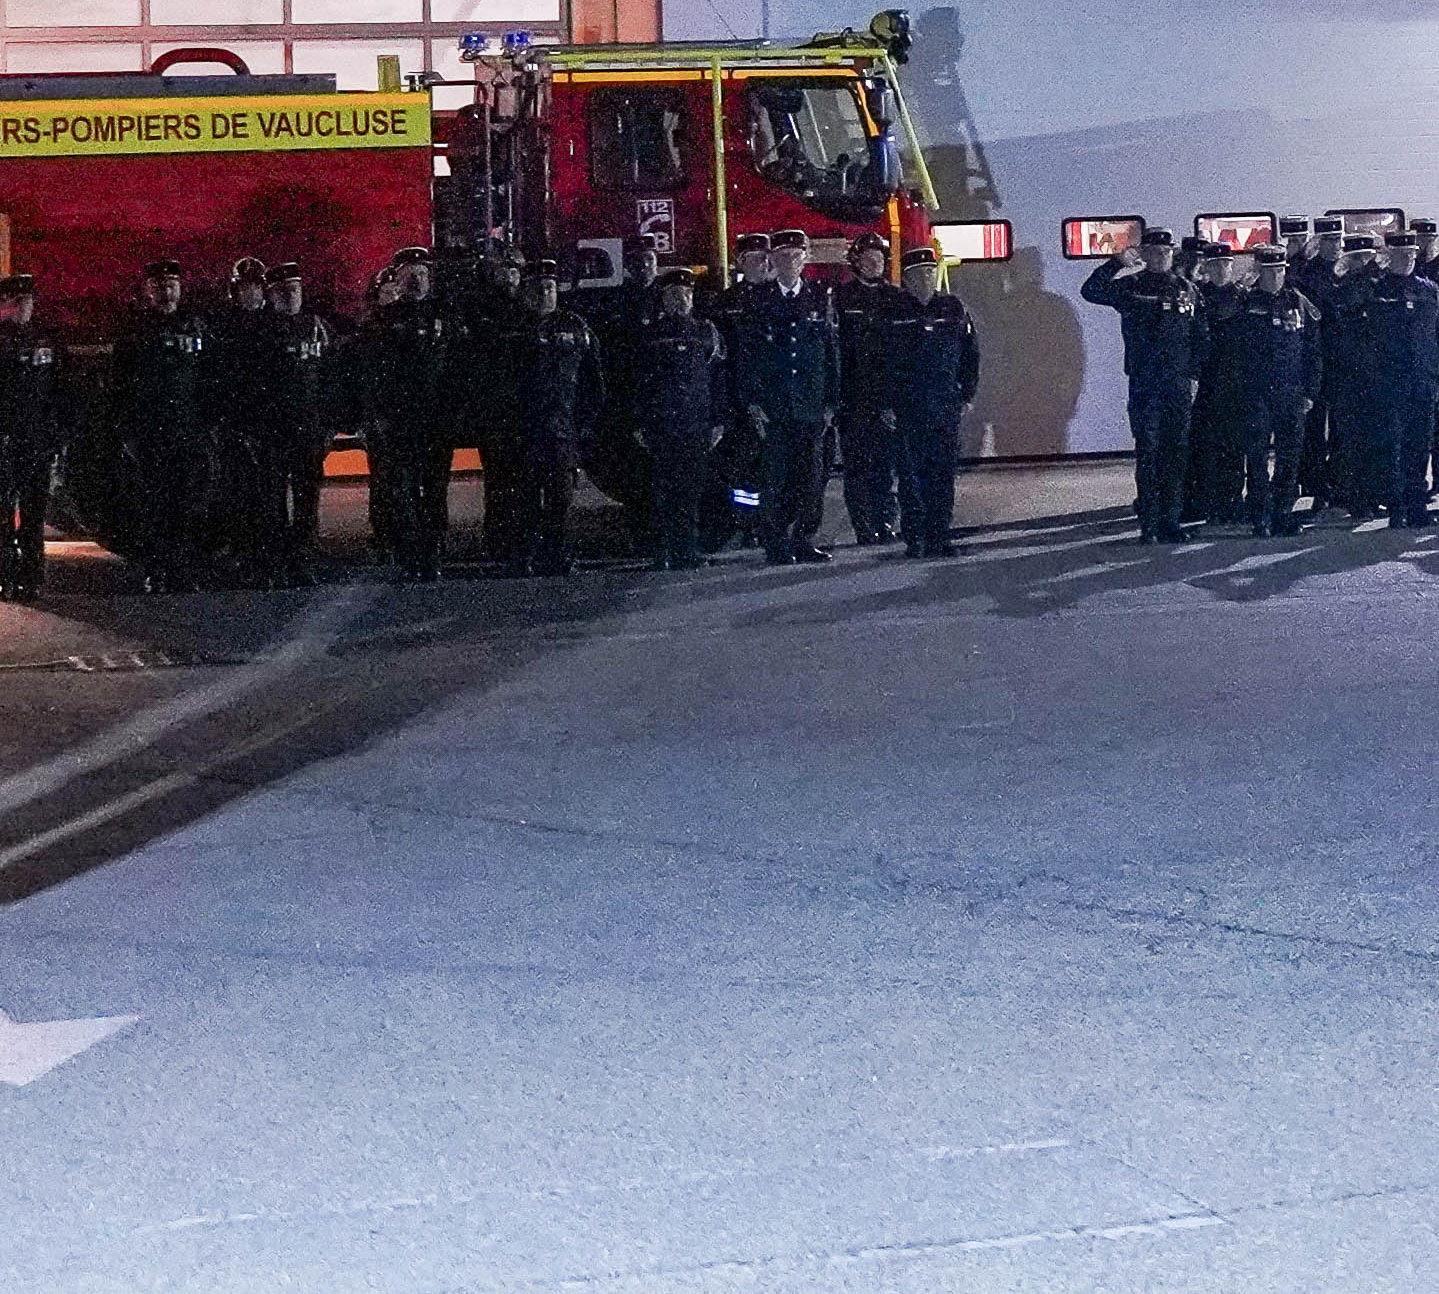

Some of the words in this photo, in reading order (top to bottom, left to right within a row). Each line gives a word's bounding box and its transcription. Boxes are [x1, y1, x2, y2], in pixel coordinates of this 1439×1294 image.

[211, 112, 249, 139] DE
[257, 109, 407, 138] VAUCLUSE
[641, 201, 669, 213] 112
